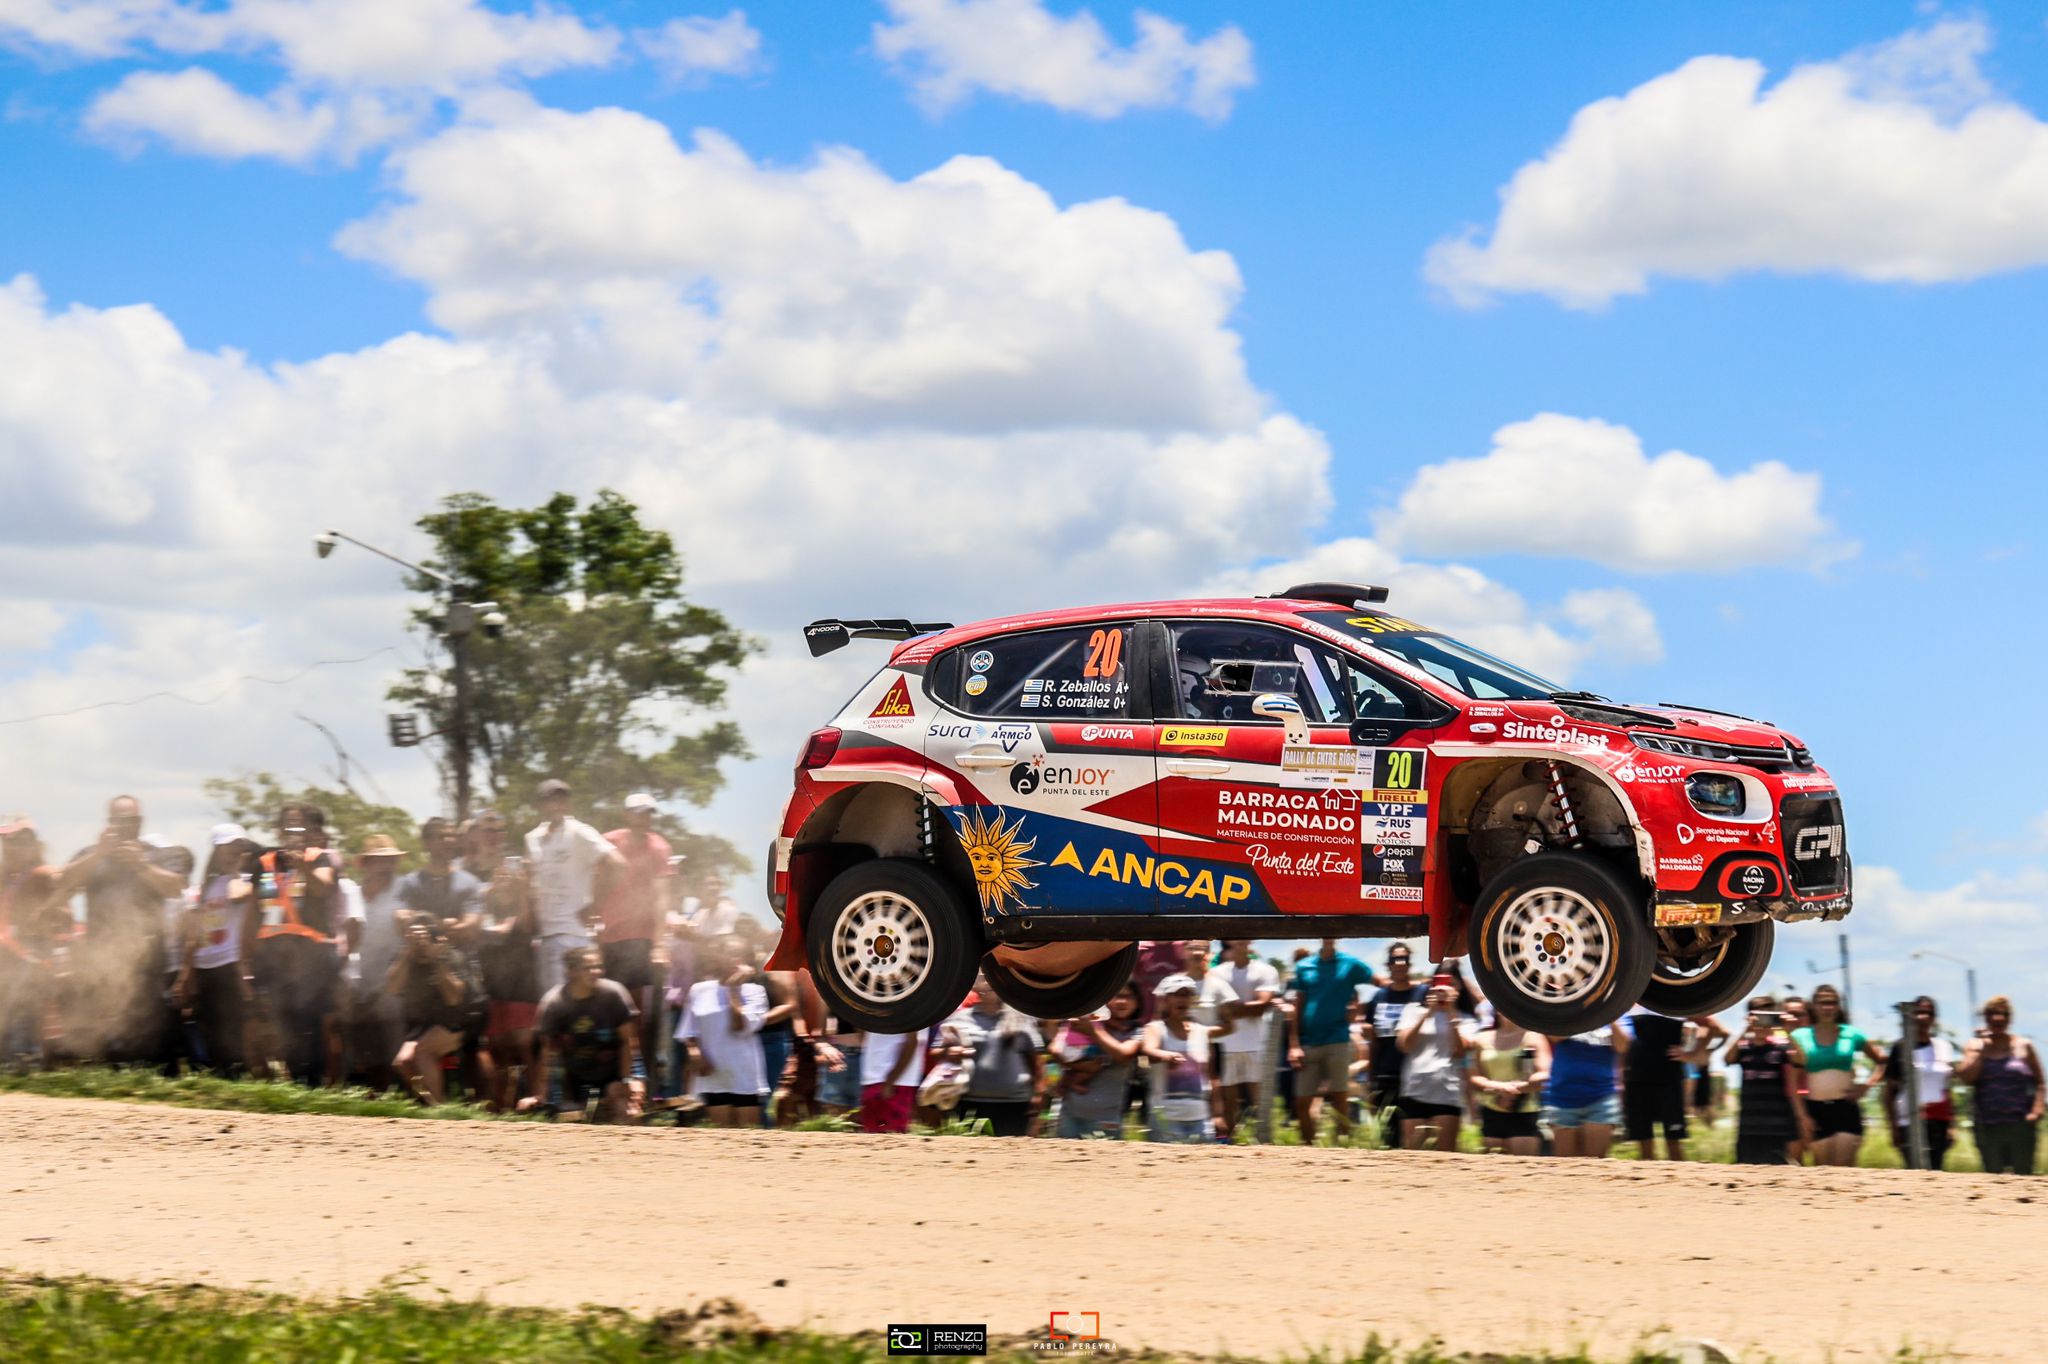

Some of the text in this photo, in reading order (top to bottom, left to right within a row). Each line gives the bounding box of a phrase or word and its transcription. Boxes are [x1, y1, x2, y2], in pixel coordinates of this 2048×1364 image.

[1083, 629, 1123, 677] 20
[1044, 680, 1129, 694] R. Zeballos A+
[875, 689, 910, 715] Sika
[1041, 695, 1053, 707] S.
[1057, 694, 1110, 708] González
[928, 724, 972, 739] sura
[991, 730, 1032, 740] ARMCO
[1180, 732, 1224, 741] Insta360
[1502, 722, 1609, 748] Sinteplast
[1284, 750, 1305, 765] RALLY
[1306, 751, 1316, 765] DE
[1316, 751, 1337, 766] ENTRE
[1338, 749, 1356, 766] RÍOS
[1386, 751, 1412, 788] 20
[1218, 790, 1320, 810] BARRACA
[1373, 790, 1418, 802] PIRELLI
[1377, 803, 1413, 816] YPF
[1217, 810, 1355, 831] MALDONADO
[1390, 818, 1411, 829] RUS
[1216, 830, 1355, 845] MATERIALES DE CONSTRUCCIÓN
[1376, 831, 1412, 839] JAC
[1725, 828, 1750, 836] Nacional
[1716, 835, 1740, 844] Deporte
[1387, 847, 1414, 857] pepsi
[1245, 843, 1355, 875] Punta del Este
[1383, 858, 1405, 869] FOX
[1088, 848, 1251, 906] ANCAP
[1276, 869, 1320, 877] URUGUAY
[1743, 876, 1765, 884] RACING
[1381, 887, 1422, 897] MAROZZI
